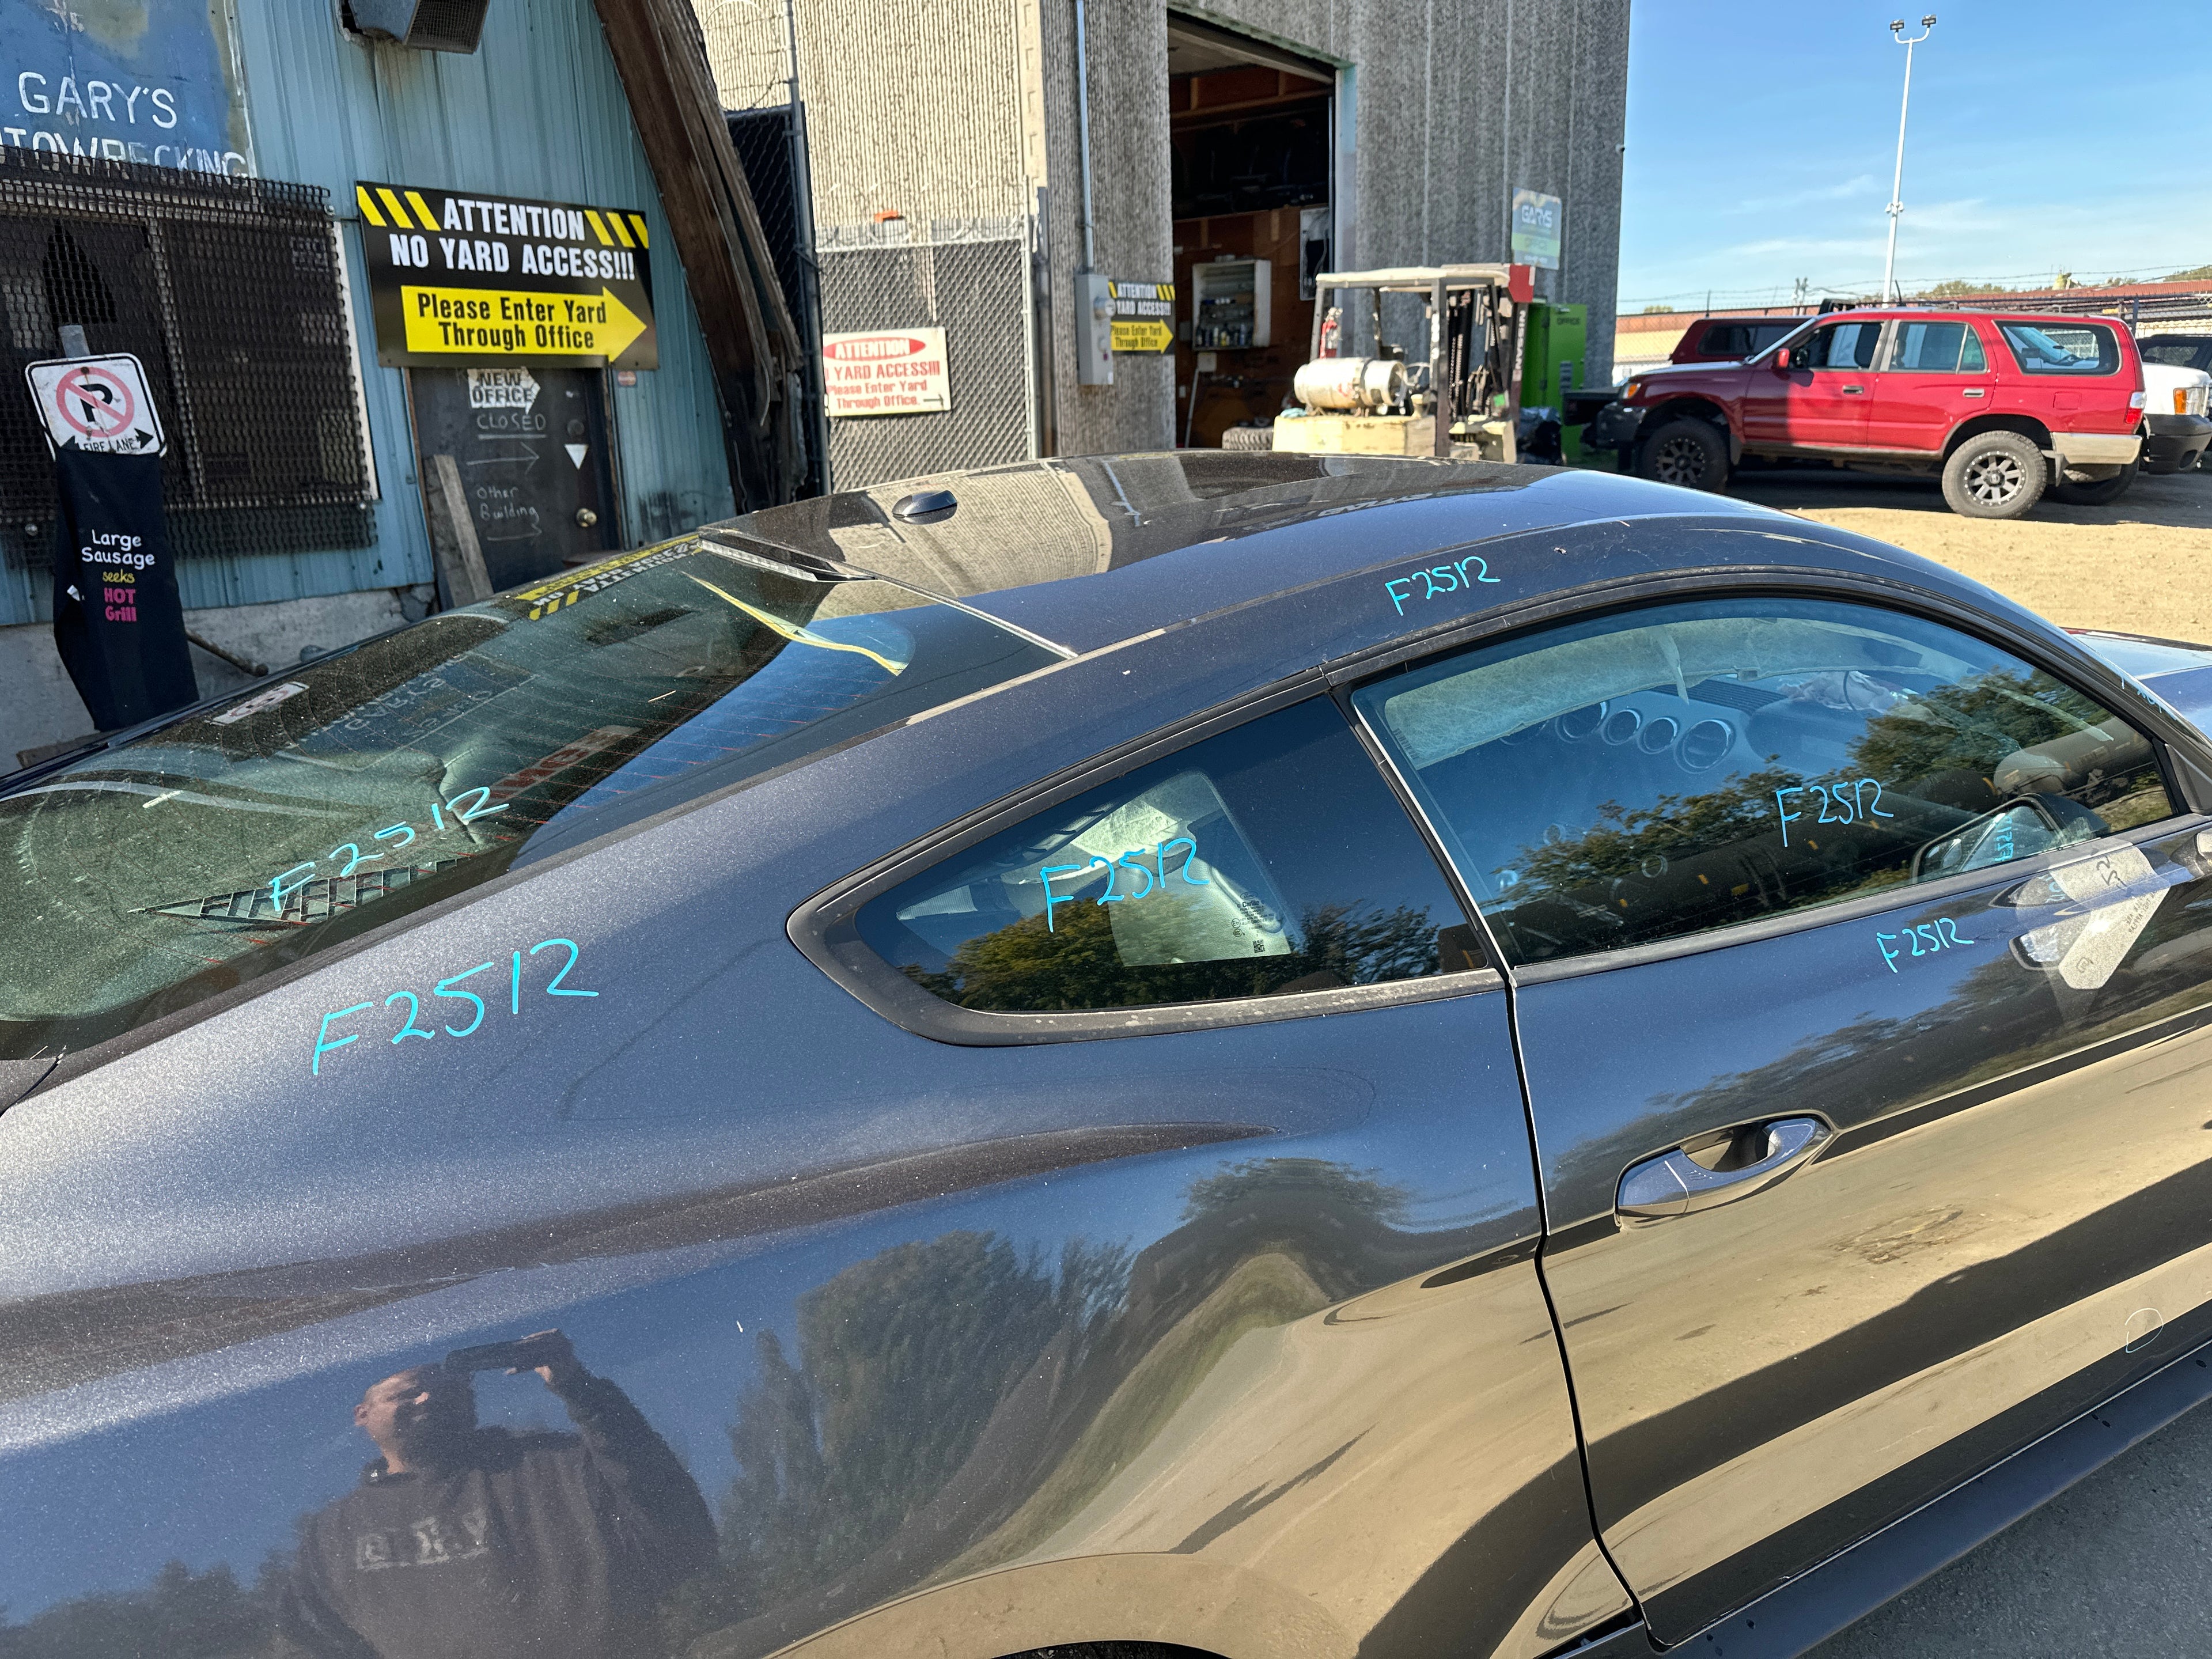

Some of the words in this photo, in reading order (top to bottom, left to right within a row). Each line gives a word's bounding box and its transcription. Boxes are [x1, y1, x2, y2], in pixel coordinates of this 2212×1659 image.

[19, 71, 177, 128] GARY'S
[444, 198, 585, 241] ATTENTION
[389, 234, 428, 267] NO
[440, 237, 510, 272] YARD
[522, 244, 635, 281] ACCESS!!!
[1118, 283, 1157, 299] ATTENTION
[418, 293, 491, 320] Please
[501, 297, 555, 322] Enter
[565, 300, 607, 323] Yard
[438, 322, 525, 351] Through
[535, 324, 594, 349] Office
[1515, 310, 1527, 370] NISSAN
[835, 339, 910, 359] ATTENTION
[478, 372, 521, 386] NEW
[834, 365, 872, 381] YARD
[877, 361, 940, 379] ACCESS!!!
[472, 386, 533, 403] OFFICE
[865, 382, 895, 394] Enter
[900, 380, 927, 392] Yard
[837, 396, 881, 410] Through
[477, 412, 546, 431] CLOSED
[84, 441, 105, 451] FIRE
[108, 438, 136, 452] LANE
[92, 529, 142, 551] Large
[81, 547, 156, 570] Sausage
[102, 569, 135, 584] seeks
[1385, 555, 1501, 616] F2512
[104, 588, 136, 604] HOT
[105, 605, 137, 622] Grill
